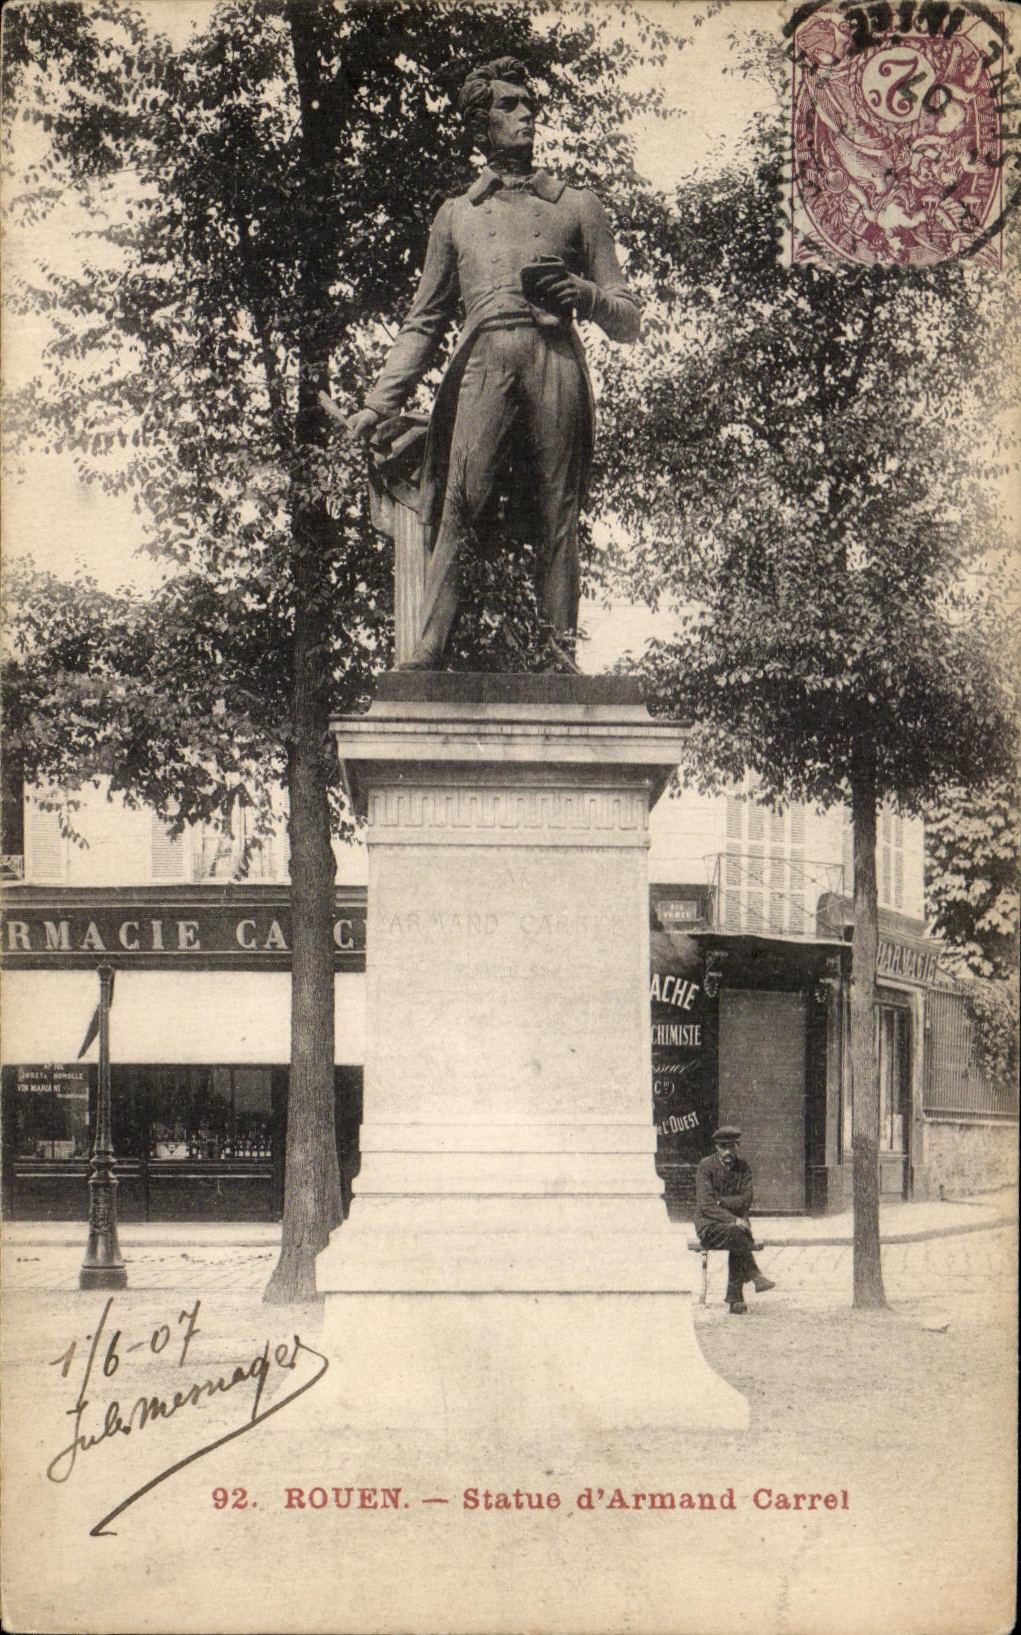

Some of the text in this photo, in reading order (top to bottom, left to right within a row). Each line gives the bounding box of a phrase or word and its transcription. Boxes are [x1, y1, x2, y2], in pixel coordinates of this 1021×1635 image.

[6, 920, 200, 950] RMACIE
[650, 973, 700, 1011] ACHE
[651, 1023, 702, 1047] CHIMISTE
[17, 1083, 29, 1092] VIN
